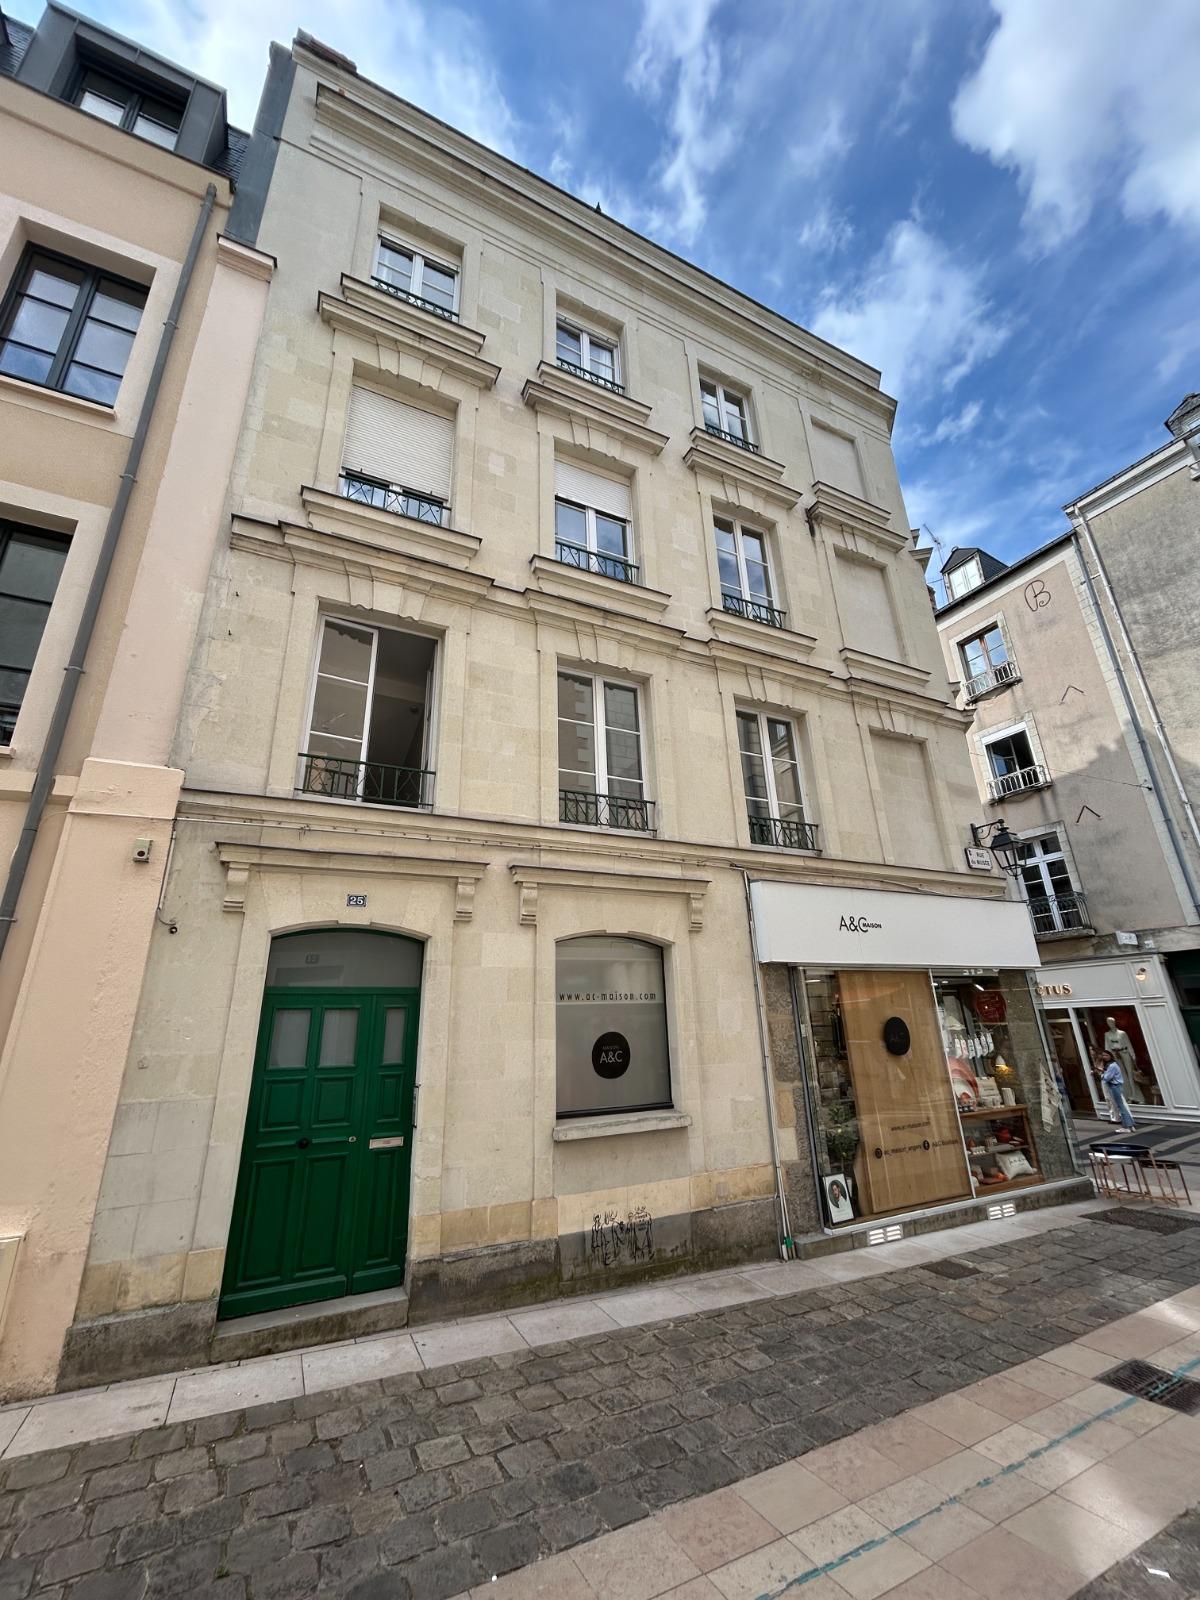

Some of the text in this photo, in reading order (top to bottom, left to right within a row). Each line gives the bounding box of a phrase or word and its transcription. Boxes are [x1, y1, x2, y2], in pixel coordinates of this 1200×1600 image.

[350, 896, 364, 905] 25
[839, 915, 869, 933] A&C
[559, 991, 656, 1001] www.ac-maison.com
[599, 1050, 623, 1064] A&C
